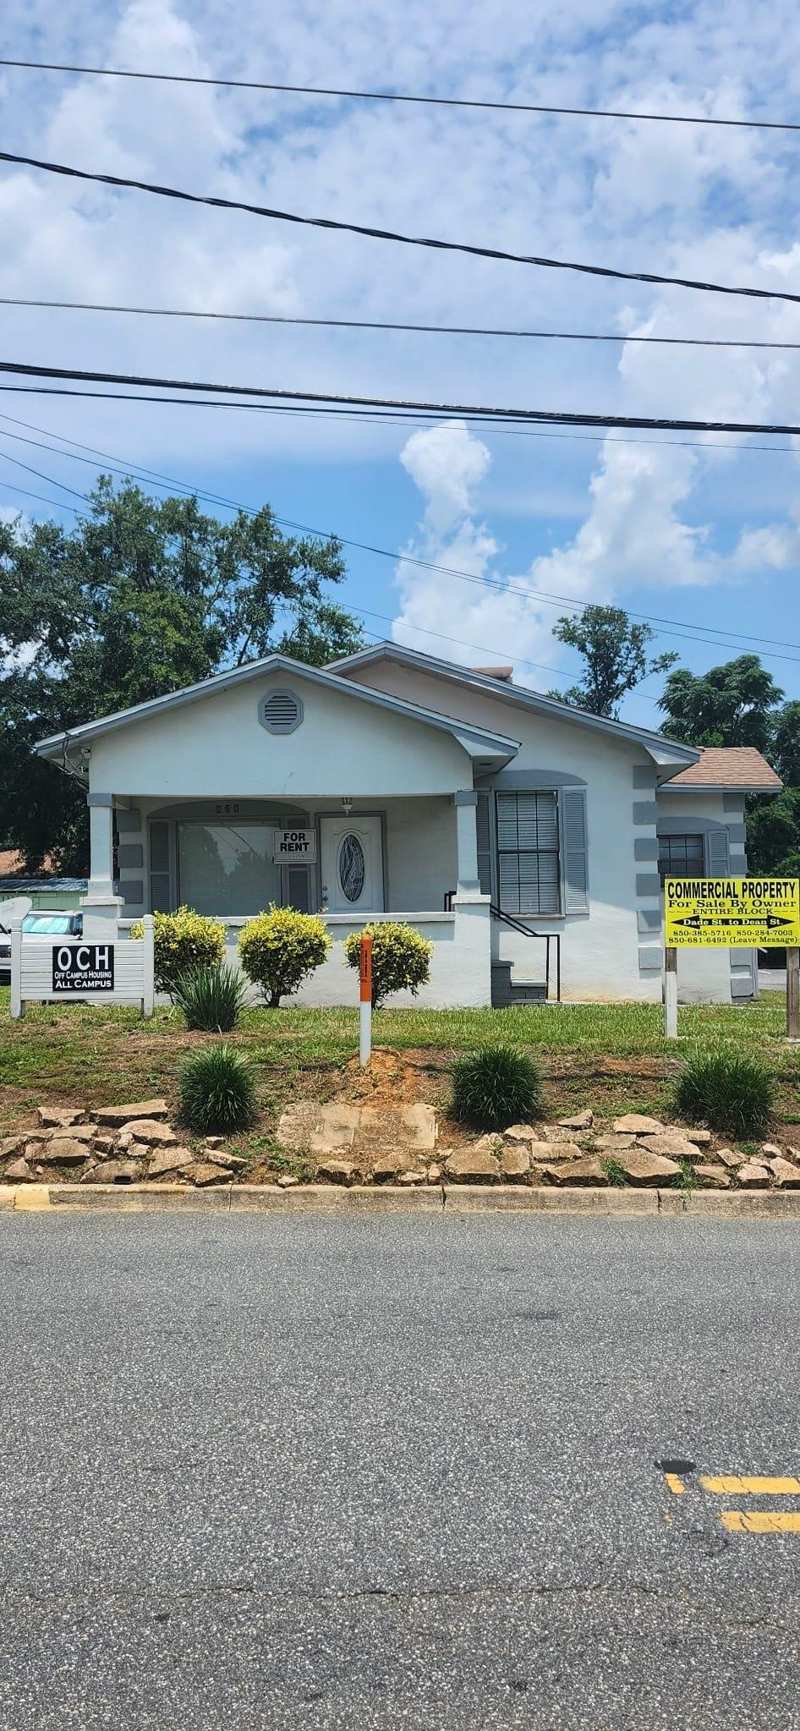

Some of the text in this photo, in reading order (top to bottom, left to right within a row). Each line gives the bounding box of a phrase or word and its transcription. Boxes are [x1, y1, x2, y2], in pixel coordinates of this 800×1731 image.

[284, 833, 305, 841] FOR
[280, 843, 310, 851] RENT
[667, 881, 795, 899] COMMERCIAL PROPERTY
[668, 900, 796, 909] For Sale By Owner
[729, 936, 757, 944] (Leave
[759, 936, 798, 945] Message)
